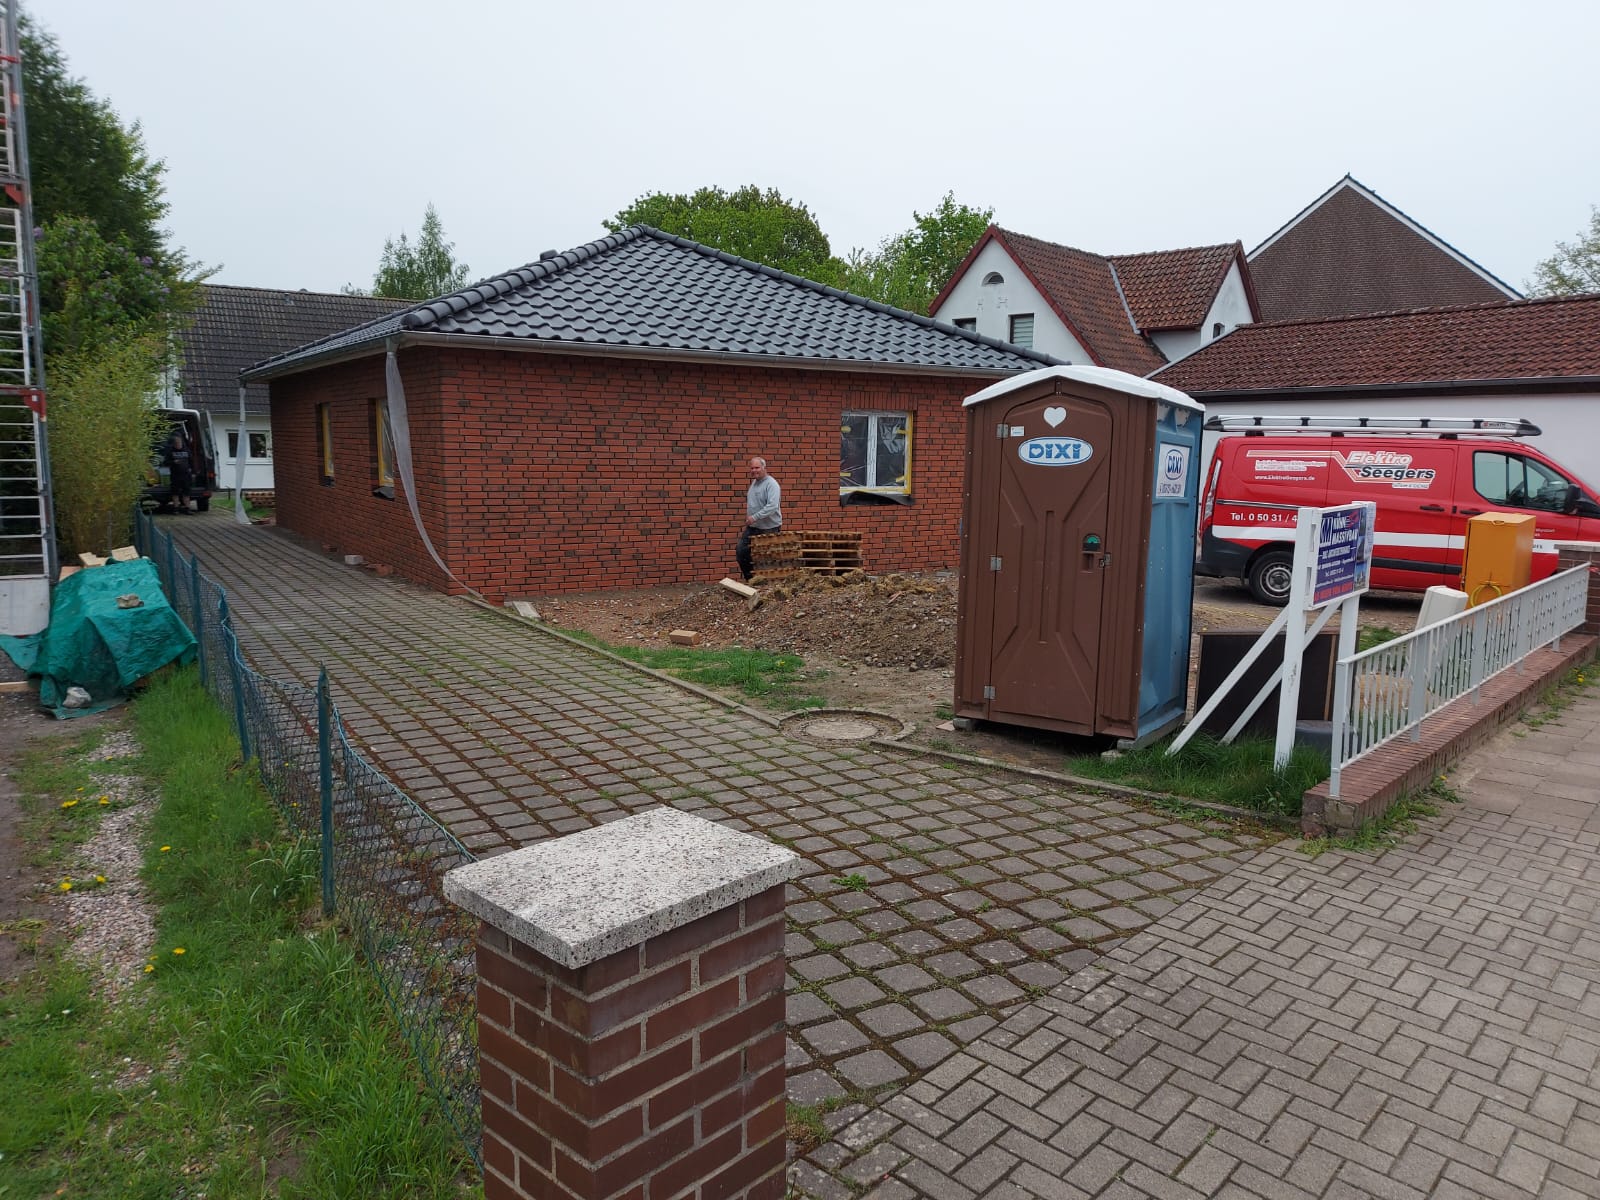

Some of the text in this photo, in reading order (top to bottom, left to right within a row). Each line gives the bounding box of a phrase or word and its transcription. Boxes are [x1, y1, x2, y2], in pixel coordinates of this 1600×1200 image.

[1028, 443, 1082, 459] DIXI
[1349, 451, 1411, 464] Elektro
[1360, 466, 1434, 480] Seegers
[1229, 512, 1246, 521] Tel.
[1248, 512, 1255, 521] 0
[1257, 513, 1269, 521] 50
[1271, 513, 1282, 522] 31
